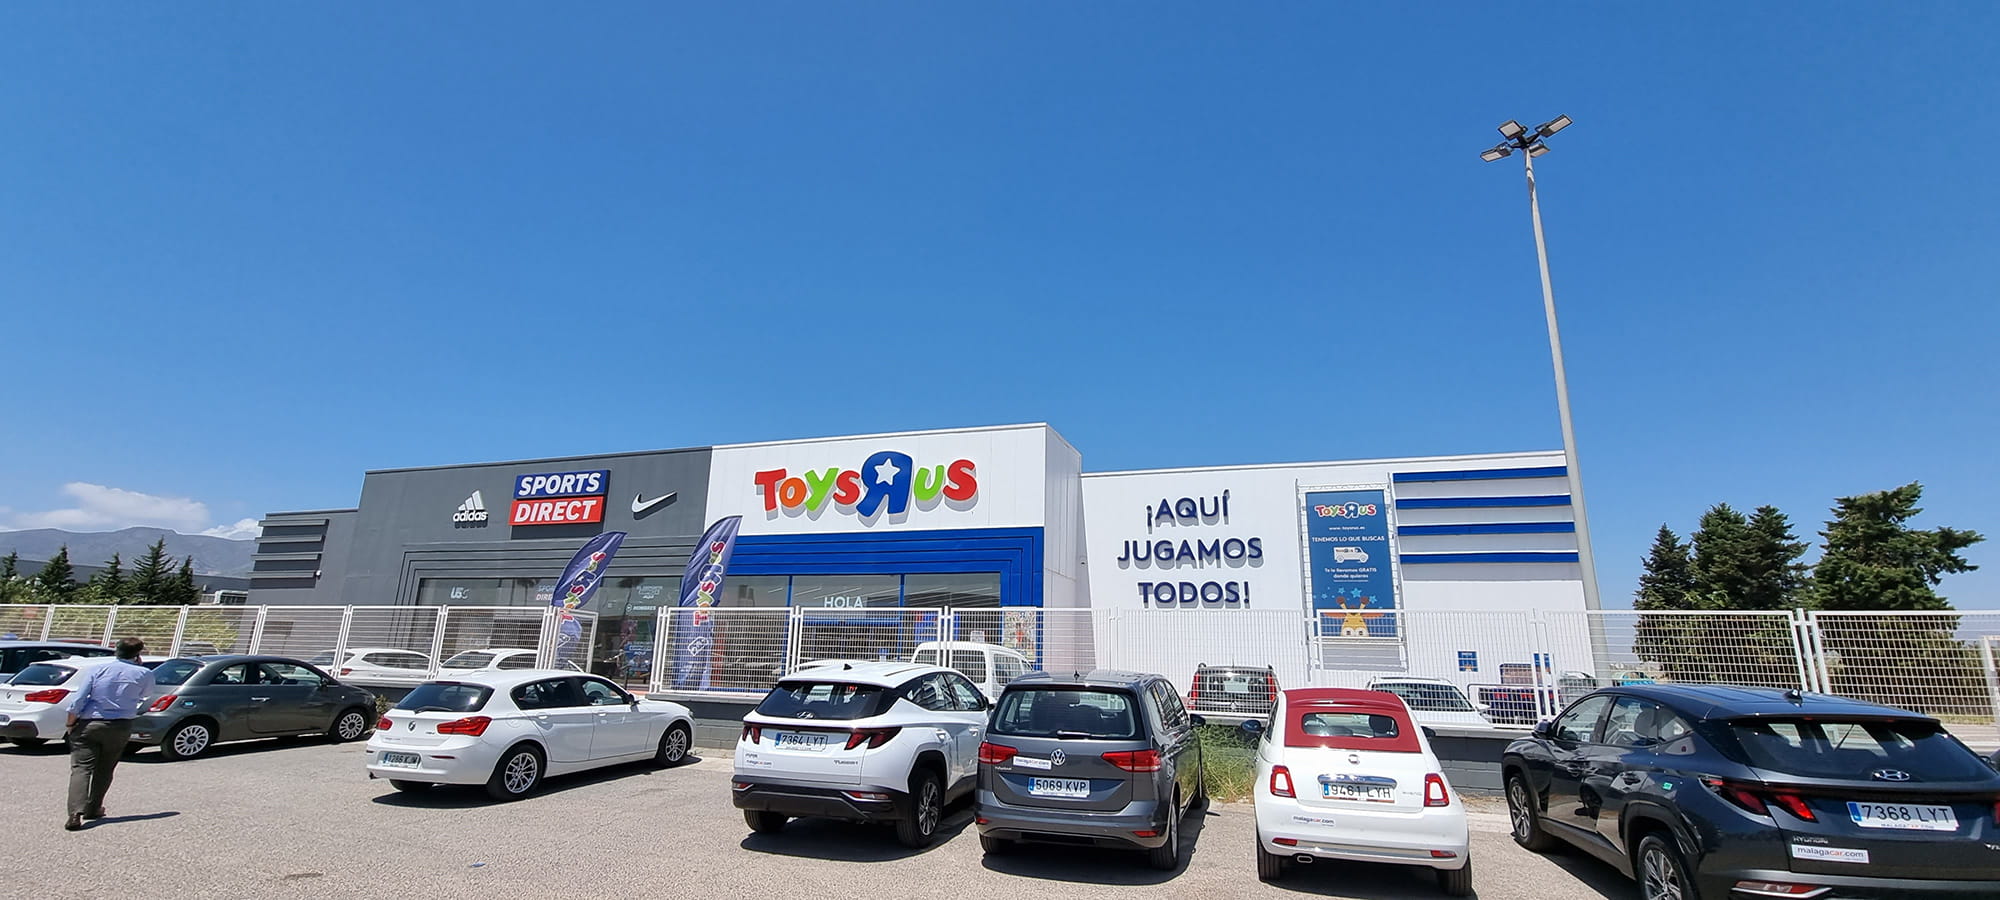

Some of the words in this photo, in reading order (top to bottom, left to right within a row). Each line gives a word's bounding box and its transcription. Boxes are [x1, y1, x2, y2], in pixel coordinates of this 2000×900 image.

[518, 473, 601, 496] SPORTS
[514, 500, 597, 523] DIRECT
[1146, 489, 1230, 527] ¡AQUÍ
[453, 510, 489, 523] adidas
[1117, 537, 1263, 562] JUGAMOS
[1138, 581, 1250, 604] TODOS!
[823, 596, 864, 608] HOLA
[781, 734, 803, 746] 7364
[806, 735, 825, 747] LYT
[1035, 780, 1063, 791] 5069
[1065, 780, 1087, 792] KVP
[1331, 785, 1361, 797] 9461
[1861, 805, 1912, 821] 7368
[1916, 807, 1950, 823] LYT
[1797, 846, 1864, 858] malagacar.com
